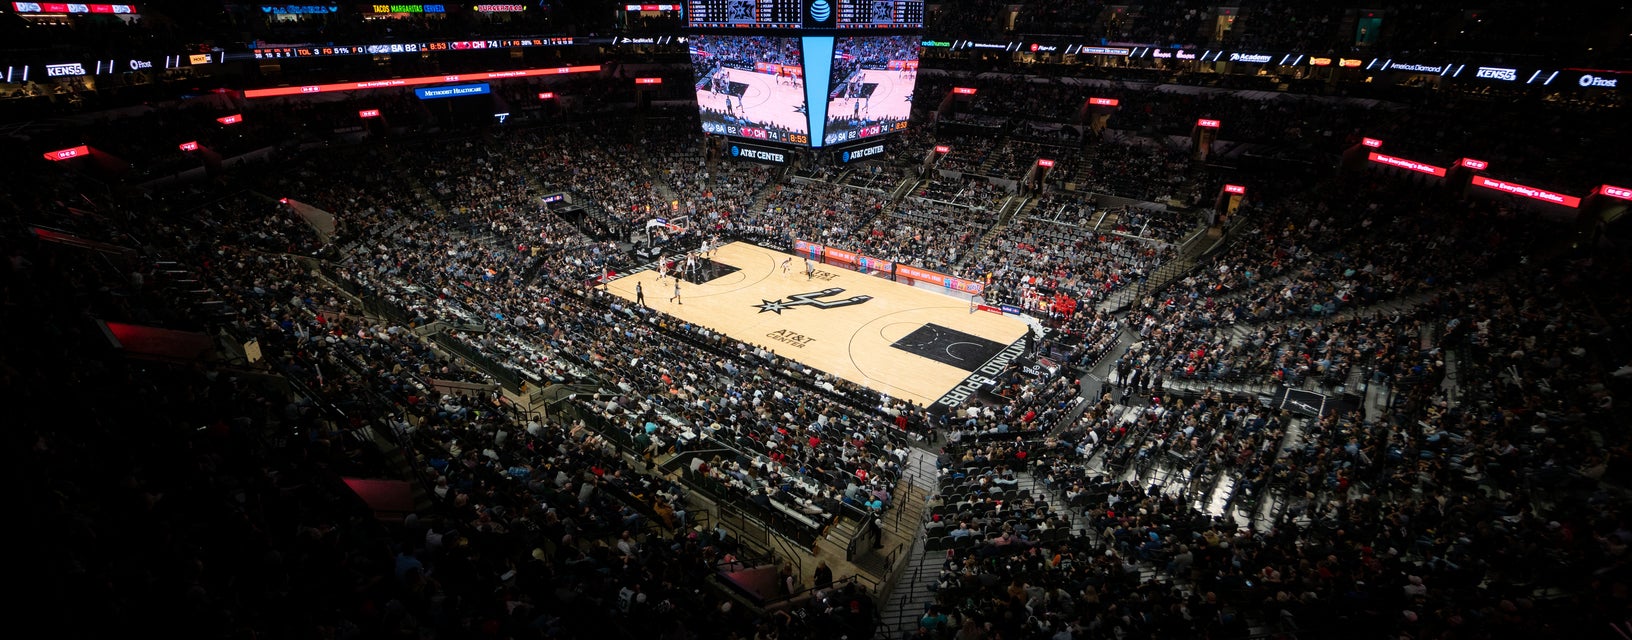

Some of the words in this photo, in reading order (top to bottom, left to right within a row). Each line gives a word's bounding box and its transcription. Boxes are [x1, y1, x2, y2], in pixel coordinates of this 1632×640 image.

[391, 44, 404, 52] SA
[137, 60, 152, 68] Frost
[1415, 64, 1442, 73] Diamond
[1592, 77, 1617, 87] Frost
[727, 126, 737, 134] 82
[754, 130, 766, 138] CHI
[768, 131, 777, 139] 74
[790, 134, 807, 143] 8:53
[838, 133, 846, 141] SA
[848, 131, 856, 139] 82
[740, 148, 756, 158] AT&T
[756, 150, 784, 163] CENTER
[850, 150, 863, 160] AT&T
[863, 145, 884, 156] CENTER
[766, 333, 806, 348] CENTER
[774, 329, 816, 344] AT&T
[939, 374, 990, 407] SPURS
